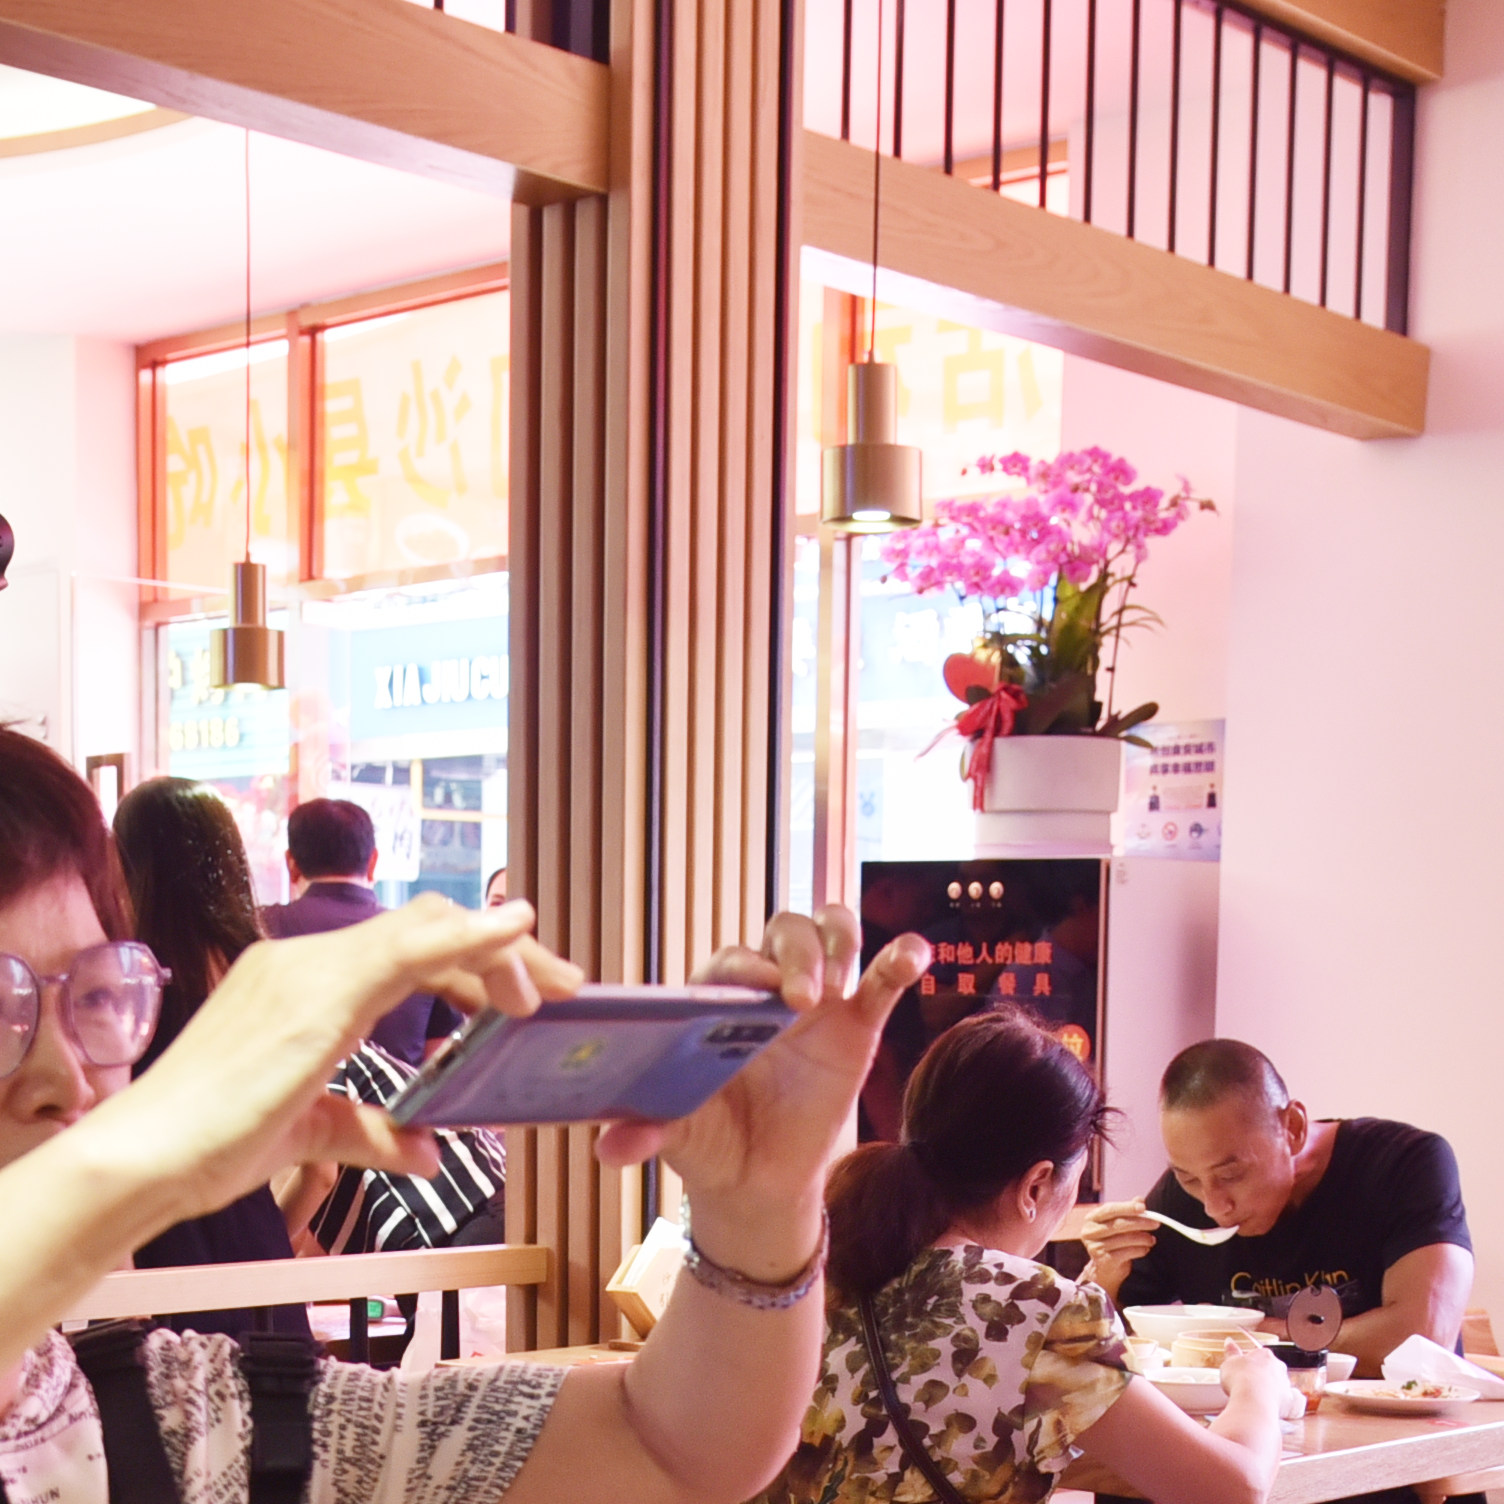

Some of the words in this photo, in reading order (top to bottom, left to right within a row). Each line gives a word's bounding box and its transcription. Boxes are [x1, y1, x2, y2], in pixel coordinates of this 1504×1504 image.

[930, 941, 1053, 966] 和他人的健康
